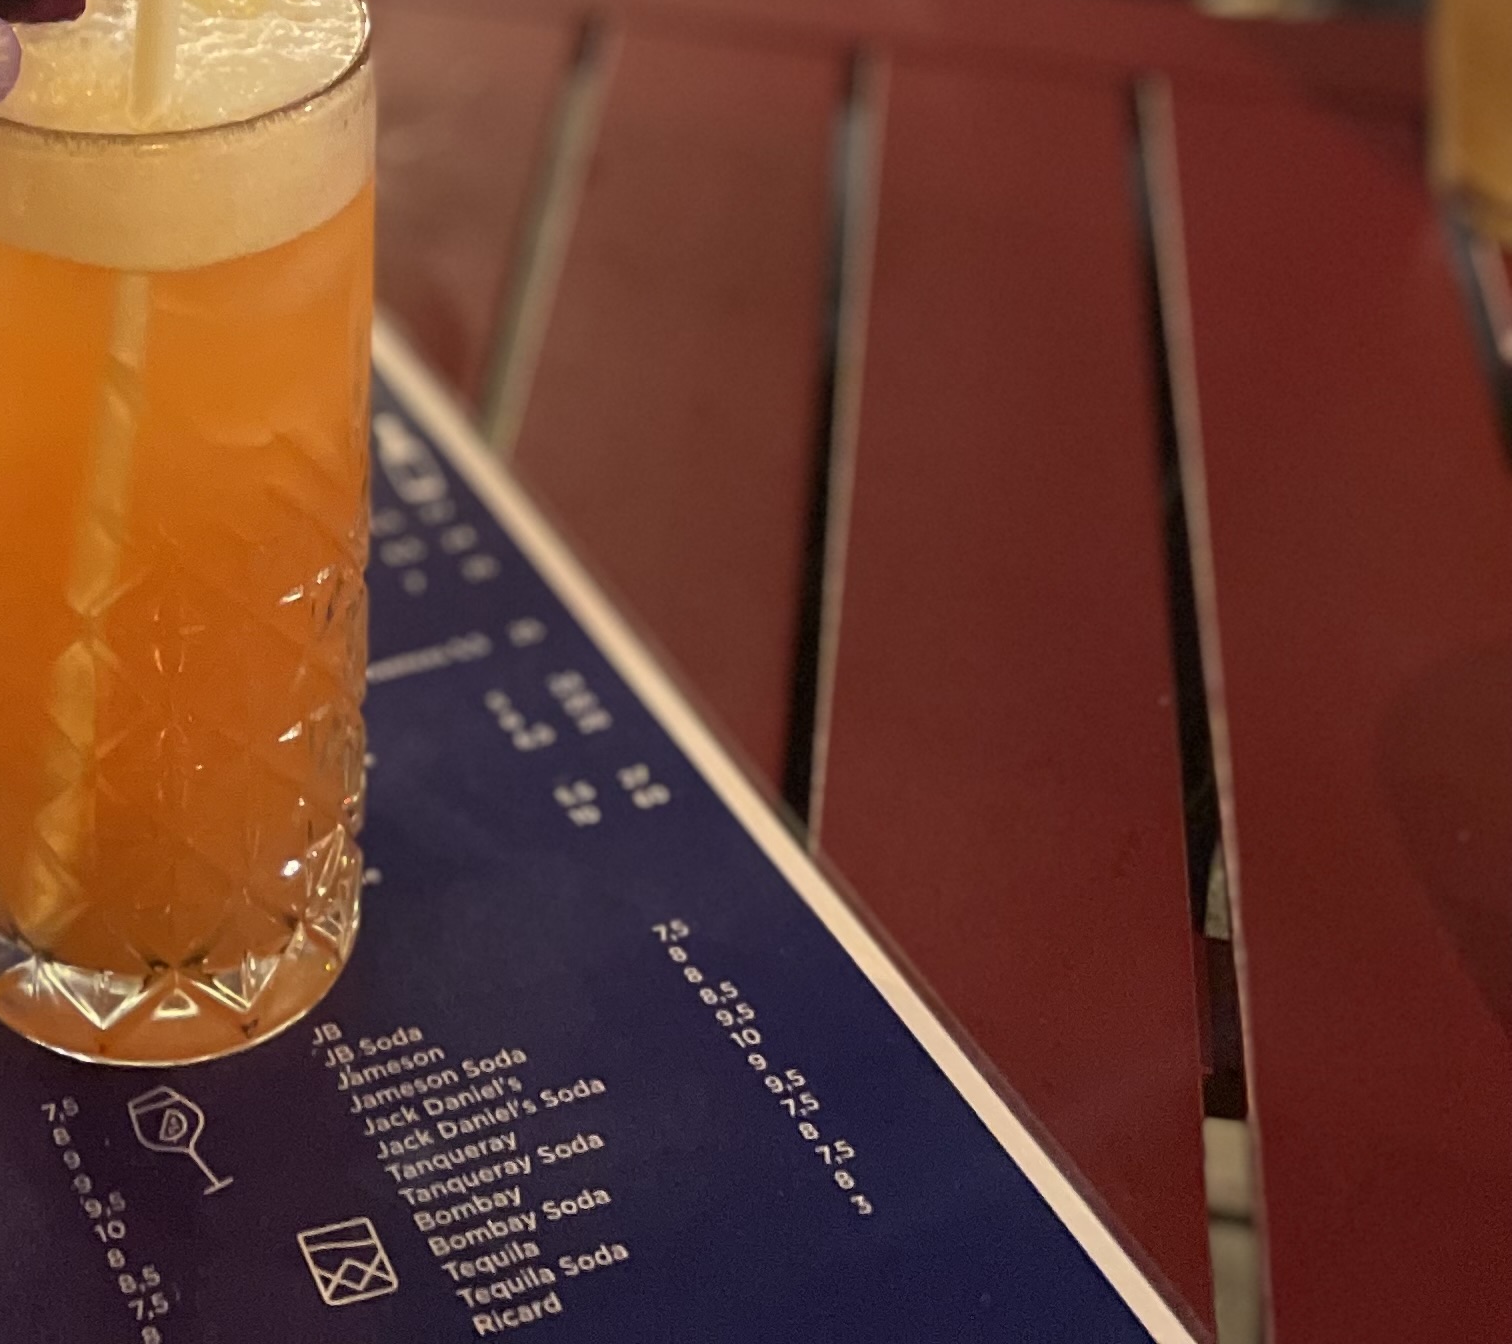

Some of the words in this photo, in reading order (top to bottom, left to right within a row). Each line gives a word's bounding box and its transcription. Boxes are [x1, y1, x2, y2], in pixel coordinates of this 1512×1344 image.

[651, 917, 690, 943] 7,5
[667, 944, 688, 963] 8
[683, 965, 704, 984] 8
[699, 980, 739, 1006] 8,5
[715, 1002, 755, 1027] 9,5
[312, 1021, 343, 1046] JB
[324, 1043, 356, 1069] JB
[358, 1025, 424, 1057] Soda
[730, 1027, 762, 1049] 10
[337, 1045, 446, 1092] Jameson
[747, 1052, 768, 1072] 9
[350, 1068, 460, 1114] Jameson
[461, 1047, 528, 1080] Soda
[764, 1067, 806, 1094] 9,5
[363, 1105, 421, 1137] Jack
[423, 1074, 523, 1117] Daniel's
[779, 1090, 820, 1118] 7,5
[377, 1127, 436, 1161] Jack
[437, 1097, 538, 1141] Daniel's
[539, 1077, 607, 1109] Soda
[798, 1120, 820, 1141] 8
[384, 1130, 518, 1184] Tanqueray
[814, 1138, 856, 1165] 7,5
[397, 1153, 532, 1207] Tanqueray
[537, 1132, 606, 1164] Soda
[834, 1168, 856, 1190] 8
[413, 1184, 522, 1232] Bombay
[849, 1194, 873, 1215] 3
[94, 1218, 127, 1243] 10
[427, 1210, 538, 1258] Bombay
[541, 1188, 612, 1221] Soda
[106, 1246, 127, 1269] 8
[441, 1240, 541, 1282] Tequila
[455, 1266, 557, 1309] Tequila
[557, 1242, 630, 1277] Soda
[128, 1290, 170, 1322] 7,5
[471, 1289, 564, 1337] Ricard
